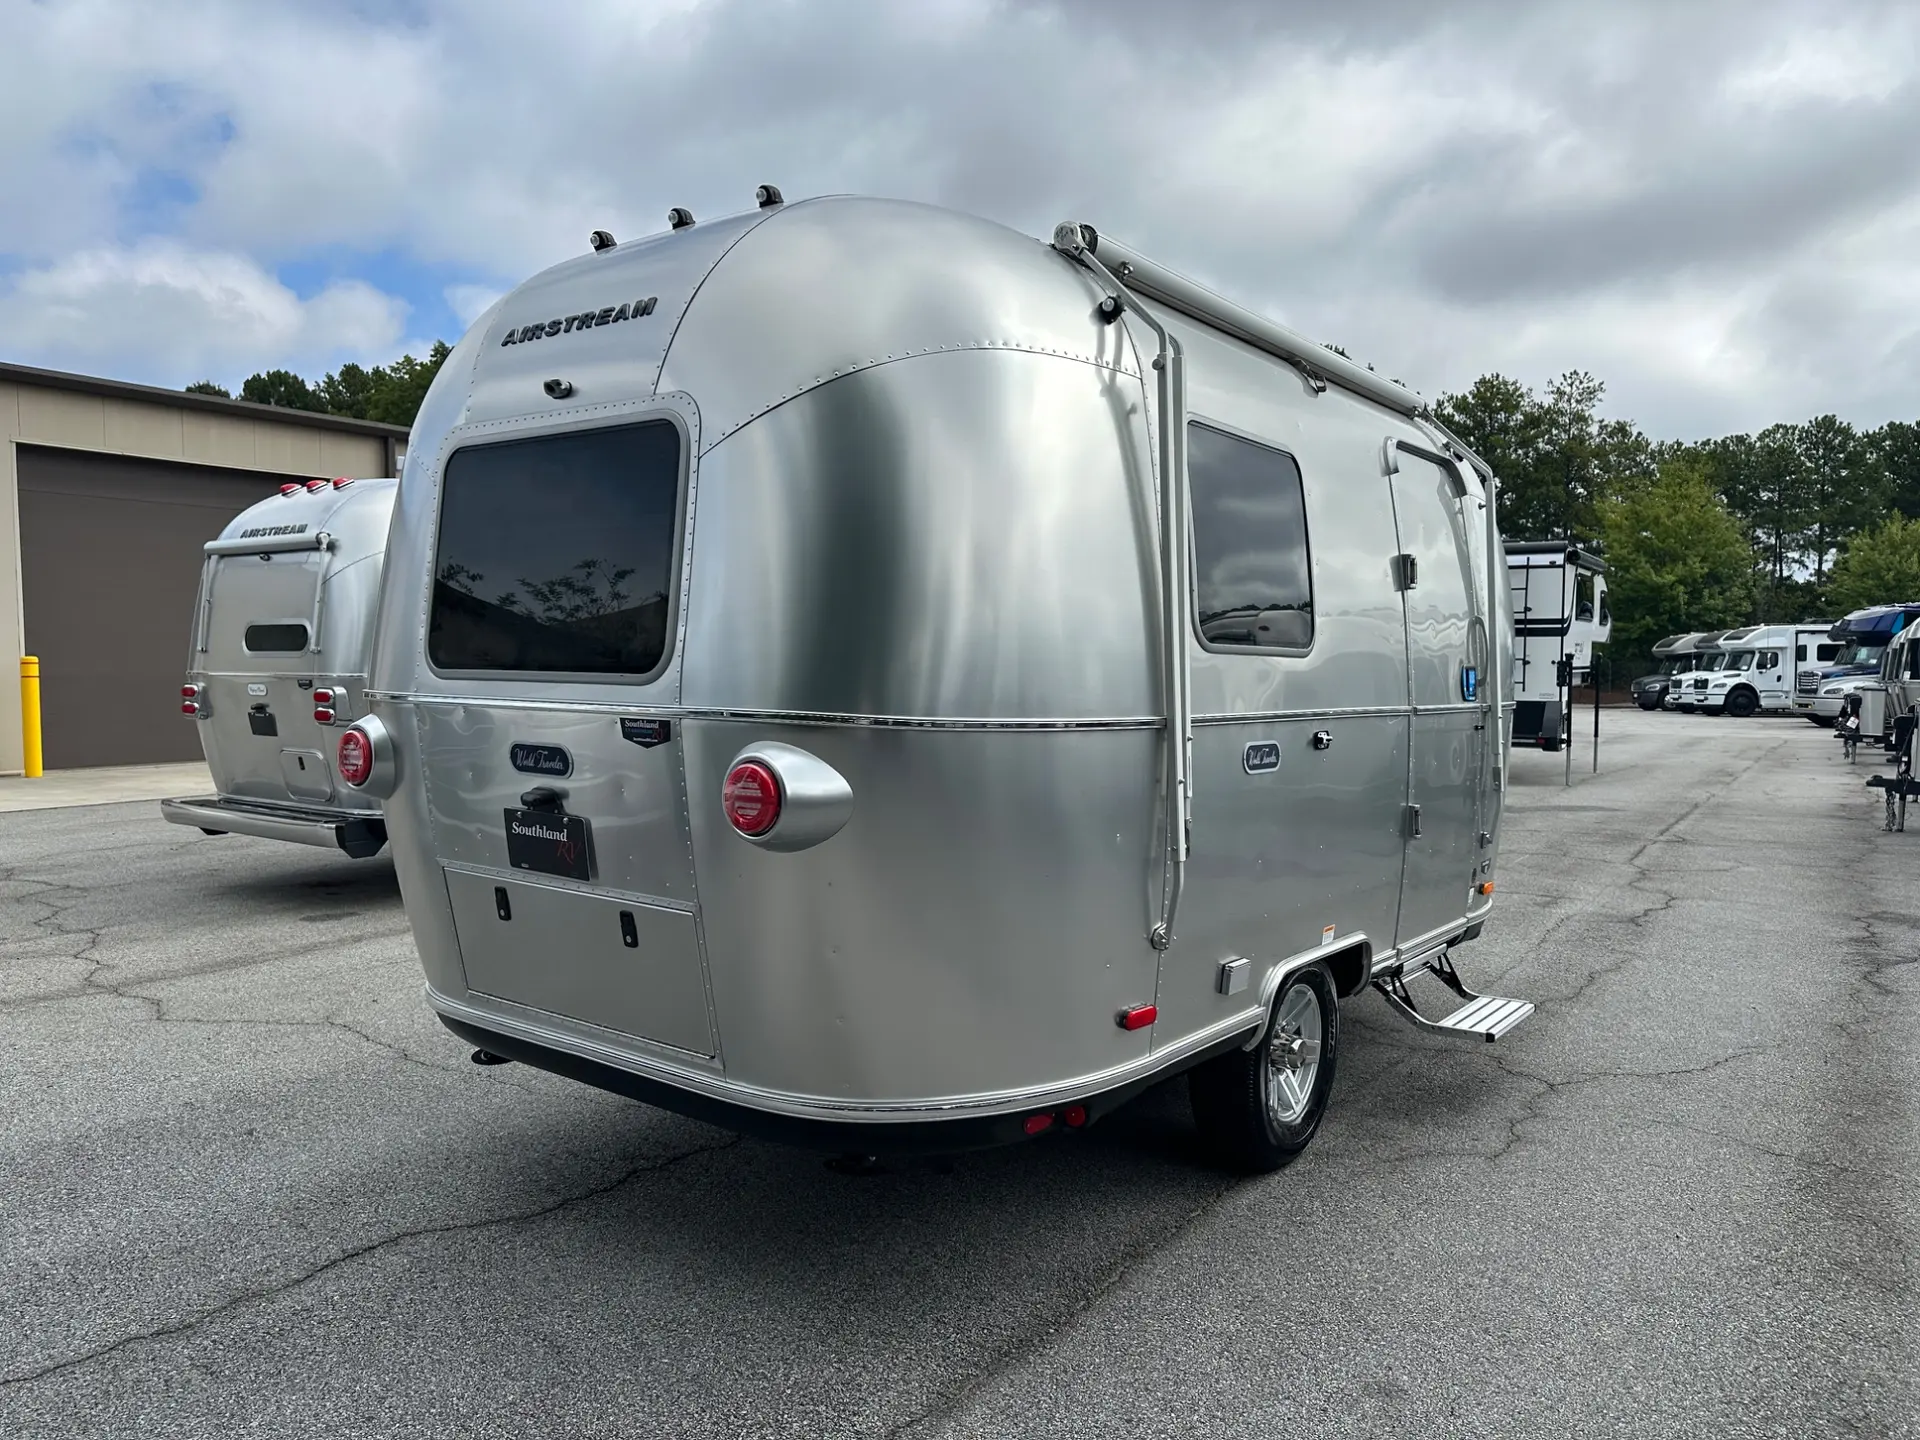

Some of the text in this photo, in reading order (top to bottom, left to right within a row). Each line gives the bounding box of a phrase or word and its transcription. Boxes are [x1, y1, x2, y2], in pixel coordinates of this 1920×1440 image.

[501, 297, 658, 347] AIRSTREAM
[240, 523, 308, 539] AIRSTREAM
[624, 719, 659, 729] Southland
[511, 821, 568, 842] Southland
[557, 841, 582, 865] RV
